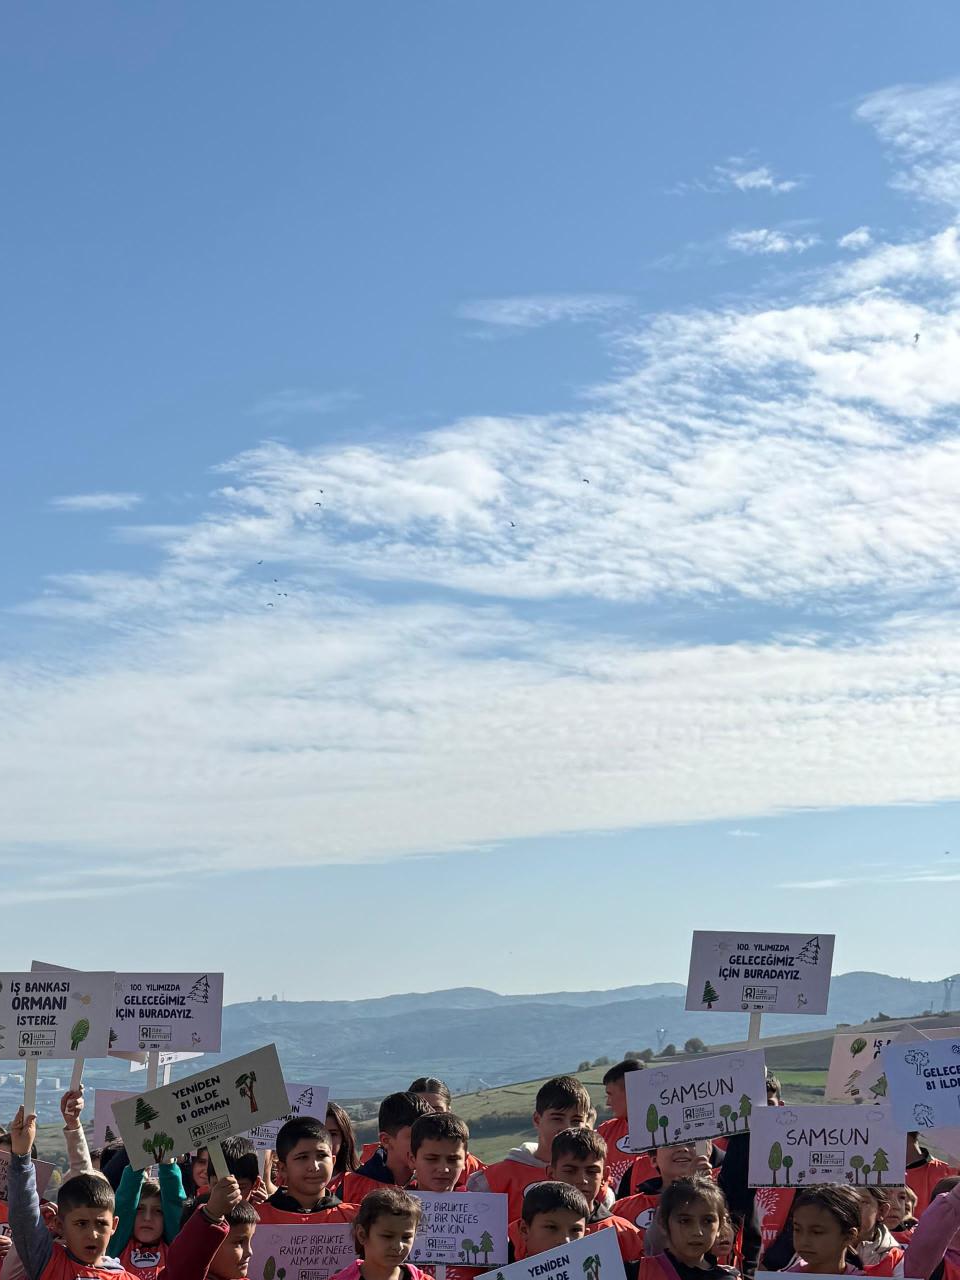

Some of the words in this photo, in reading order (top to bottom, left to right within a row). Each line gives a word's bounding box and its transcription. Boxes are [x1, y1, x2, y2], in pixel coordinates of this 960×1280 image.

[754, 944, 790, 952] YILIMIZDA
[729, 954, 795, 966] GELECEĞİMİZ
[719, 967, 740, 981] İÇİN
[744, 970, 802, 980] BURADAYIZ.
[11, 980, 21, 996] İŞ
[25, 982, 70, 992] BANKASI
[12, 996, 66, 1010] ORMANI
[125, 994, 186, 1005] GELECEĞİMİZ
[116, 1007, 134, 1020] İÇİN
[139, 1009, 194, 1019] BURADAYIZ.
[172, 1076, 221, 1099] YENİDEN
[926, 1080, 936, 1090] 81
[660, 1077, 734, 1106] SAMSUN
[177, 1114, 186, 1124] 81
[191, 1098, 230, 1119] ORMAN
[181, 1100, 190, 1110] 81
[786, 1128, 869, 1146] SAMSUN
[451, 1214, 478, 1223] NEFES
[291, 1235, 307, 1245] HEP
[280, 1246, 307, 1255] RAHAT
[326, 1246, 353, 1254] NEFES
[290, 1256, 319, 1265] ALMAK
[528, 1255, 570, 1277] YENİDEN
